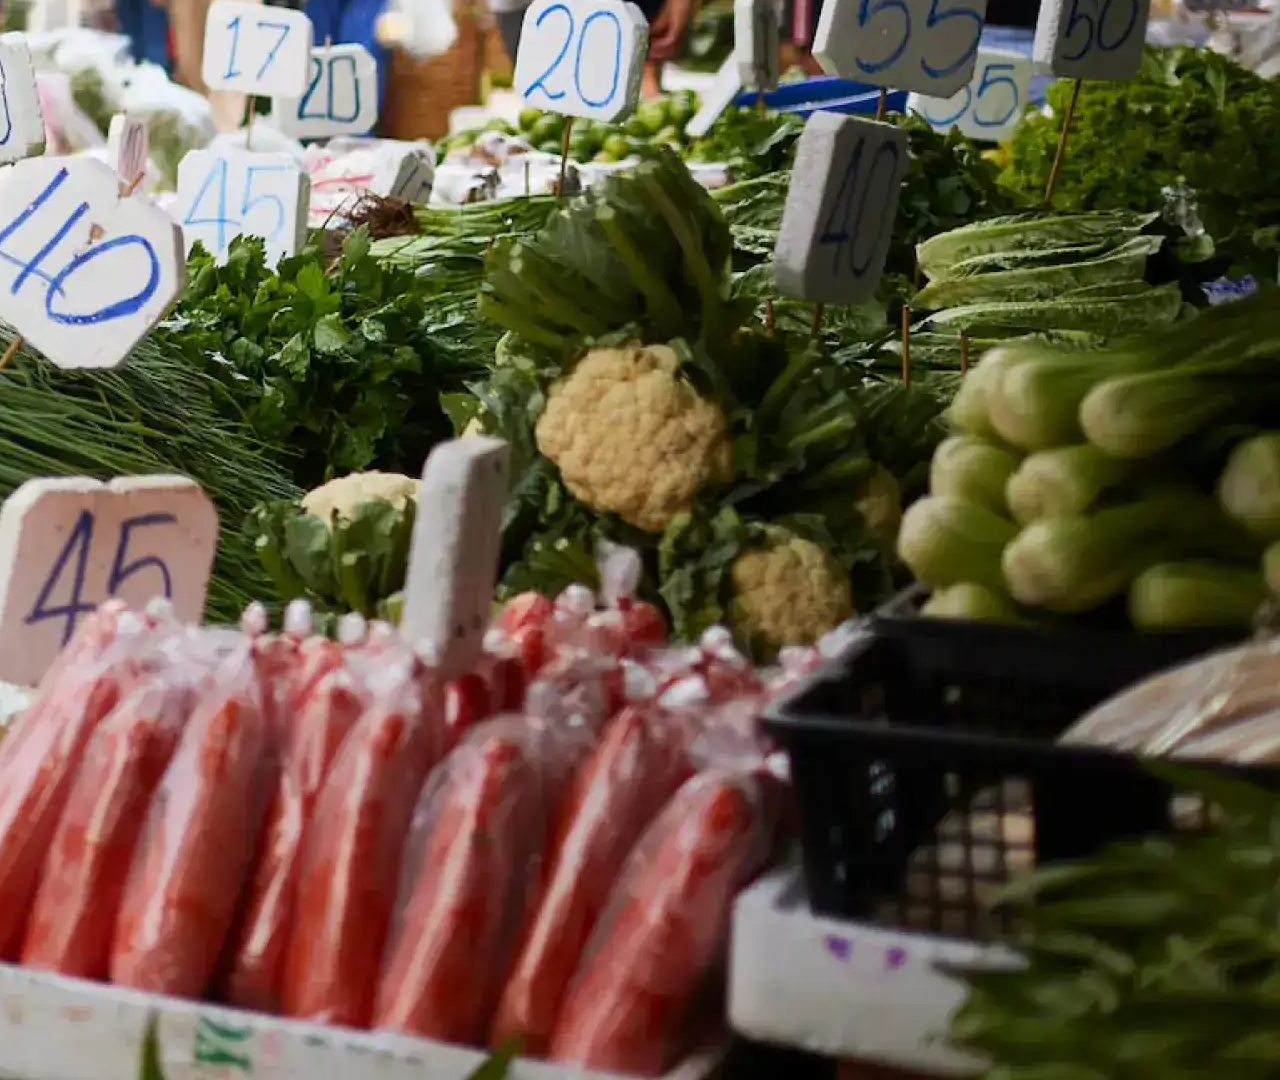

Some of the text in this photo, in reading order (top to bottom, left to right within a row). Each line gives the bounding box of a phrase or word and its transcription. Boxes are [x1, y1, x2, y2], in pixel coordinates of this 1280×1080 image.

[223, 14, 292, 82] 17
[296, 53, 363, 124] 20
[522, 3, 623, 110] 20
[183, 157, 285, 253] 45
[818, 135, 900, 279] 40
[24, 508, 178, 649] 45
